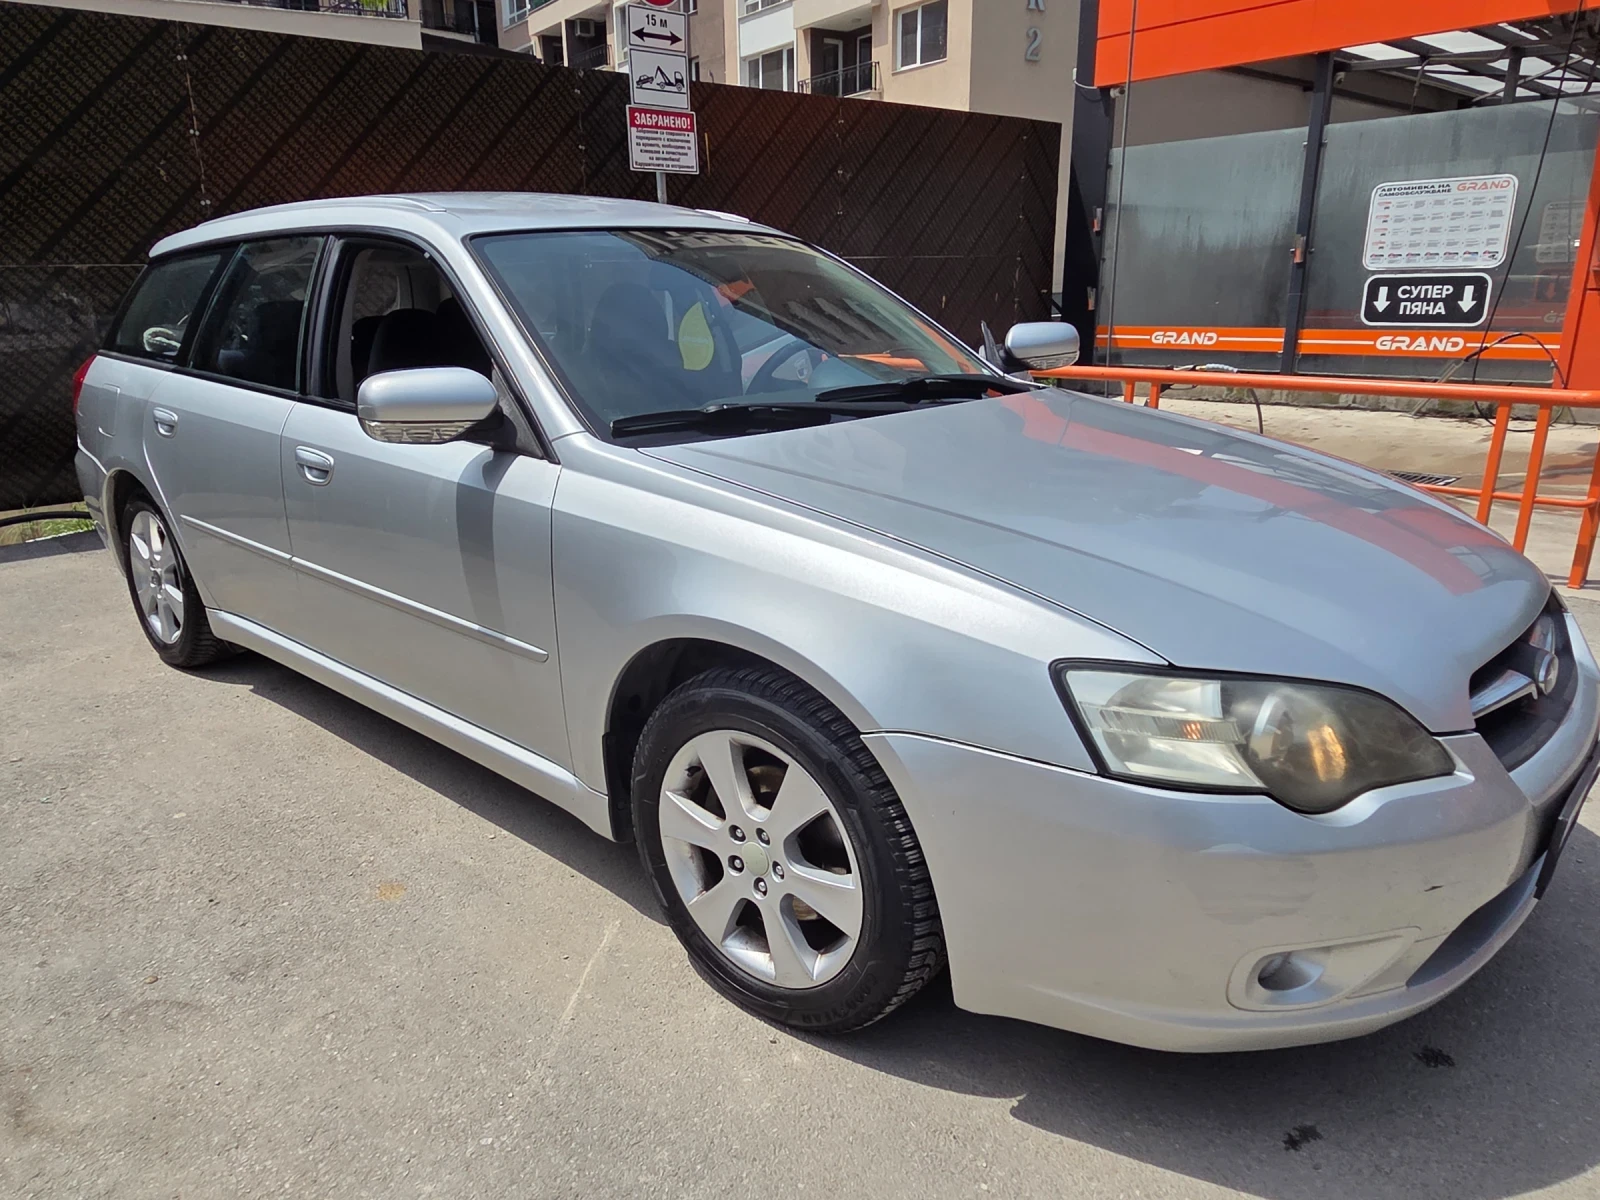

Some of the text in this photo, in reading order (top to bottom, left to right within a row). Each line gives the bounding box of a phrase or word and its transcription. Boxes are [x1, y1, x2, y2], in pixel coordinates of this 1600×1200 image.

[646, 14, 657, 26] 15
[1025, 27, 1042, 62] 2
[634, 112, 691, 130] ЗАБРАНЕНО!
[1380, 183, 1436, 193] АВТОМИВКА
[1456, 179, 1512, 192] GRAND
[1378, 188, 1453, 198] САМООБСЛУЖВАНЕ
[1397, 285, 1454, 299] СУПЕР
[1399, 301, 1446, 315] ПЯНА
[1151, 330, 1218, 346] GRAND
[1375, 335, 1465, 352] GRAND
